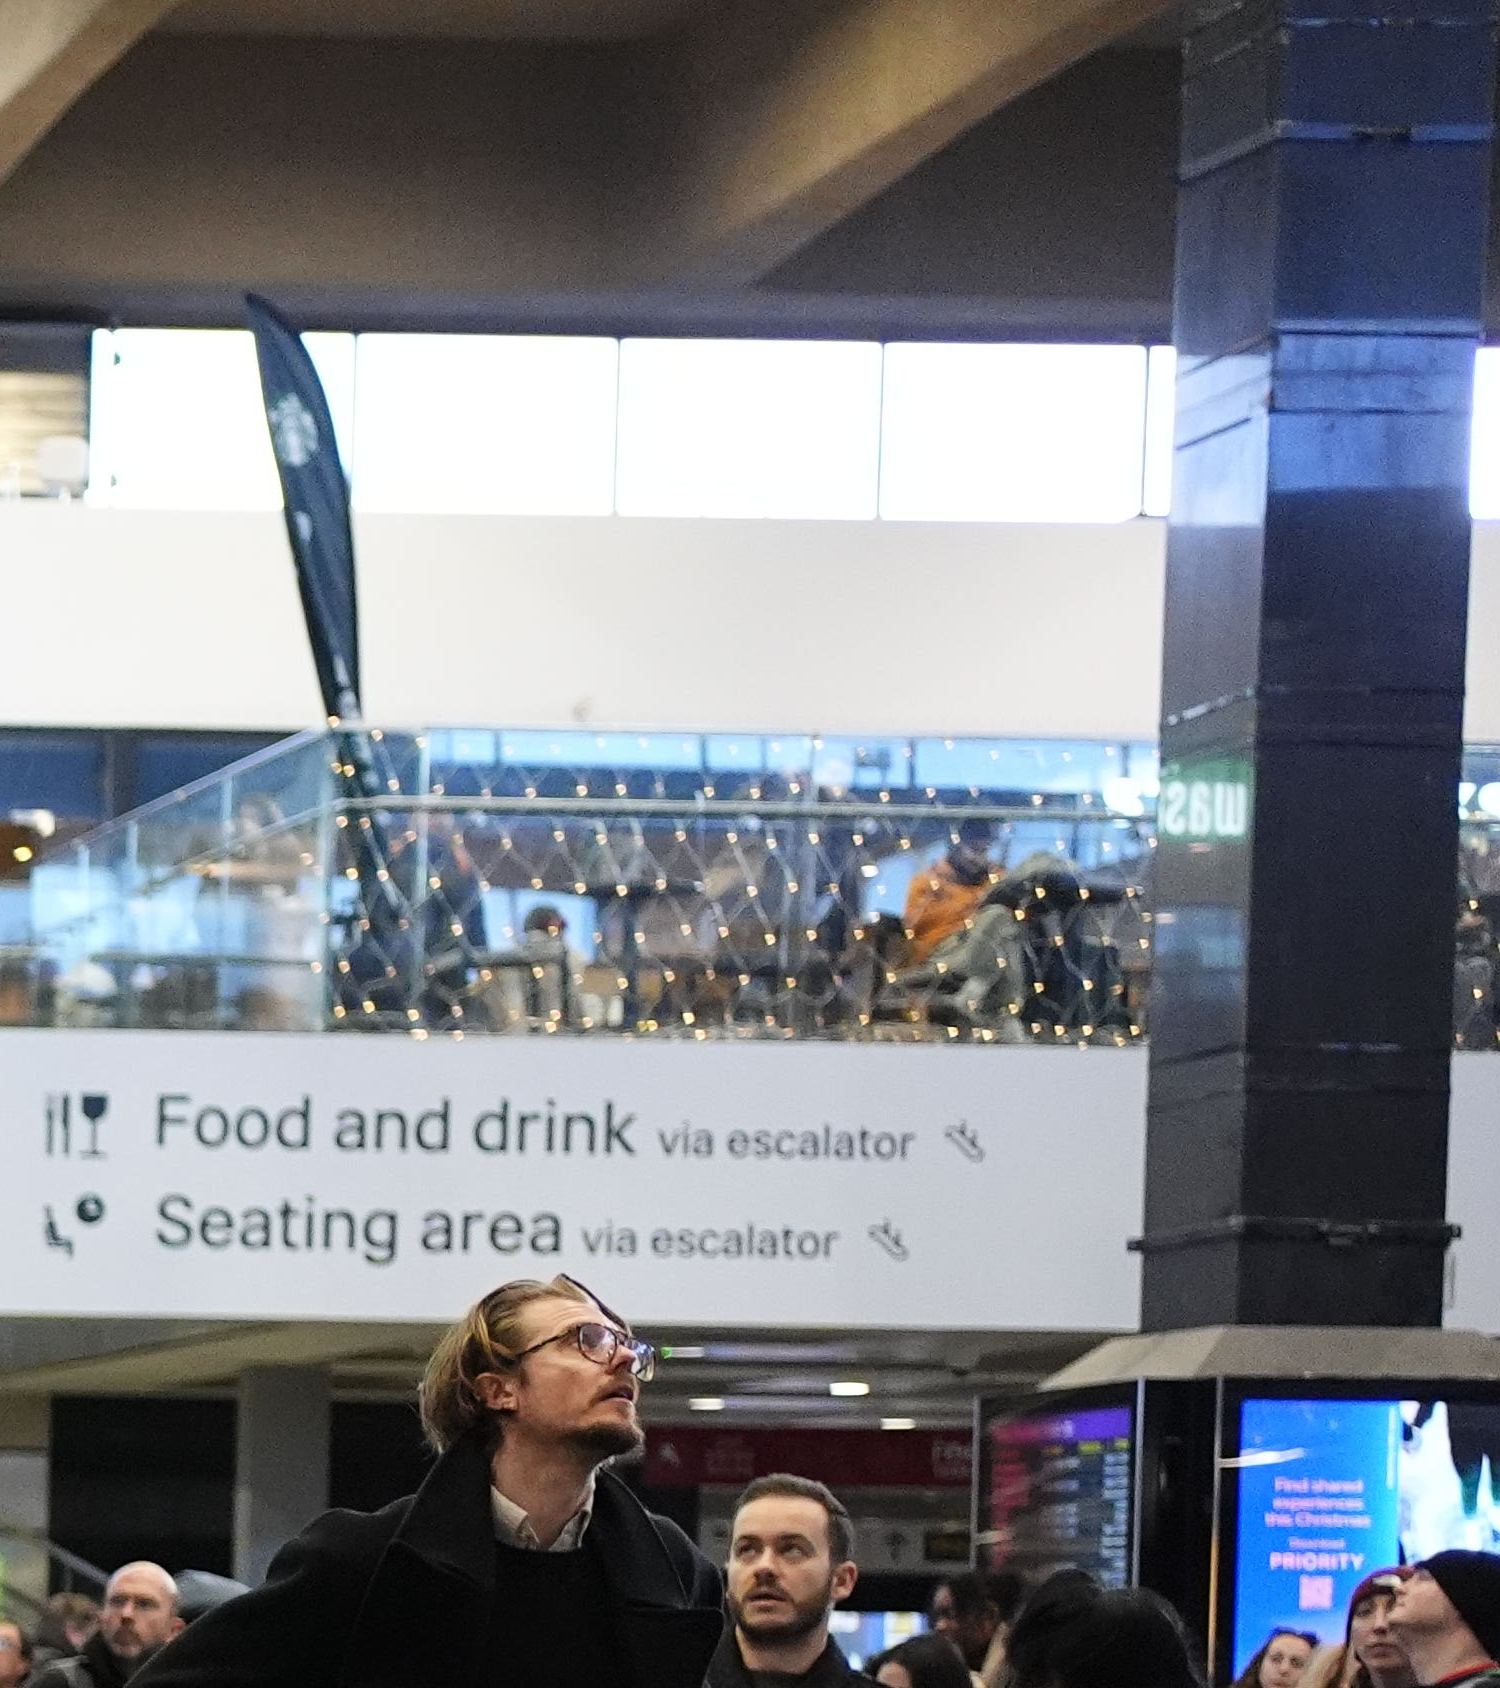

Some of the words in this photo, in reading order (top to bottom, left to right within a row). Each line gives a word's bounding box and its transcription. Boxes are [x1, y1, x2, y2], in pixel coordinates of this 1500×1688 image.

[155, 1092, 312, 1151] Food
[332, 1096, 452, 1153] and
[472, 1097, 637, 1157] drink
[658, 1124, 714, 1159] via
[726, 1121, 916, 1162] escalator
[154, 1193, 400, 1267] Seating
[420, 1210, 563, 1256] area
[581, 1224, 639, 1258] via
[649, 1221, 843, 1262] escalator
[1312, 1478, 1364, 1494] shared
[1265, 1513, 1294, 1527] this
[1295, 1512, 1372, 1528] Christmas
[1269, 1551, 1364, 1571] PRIORITY
